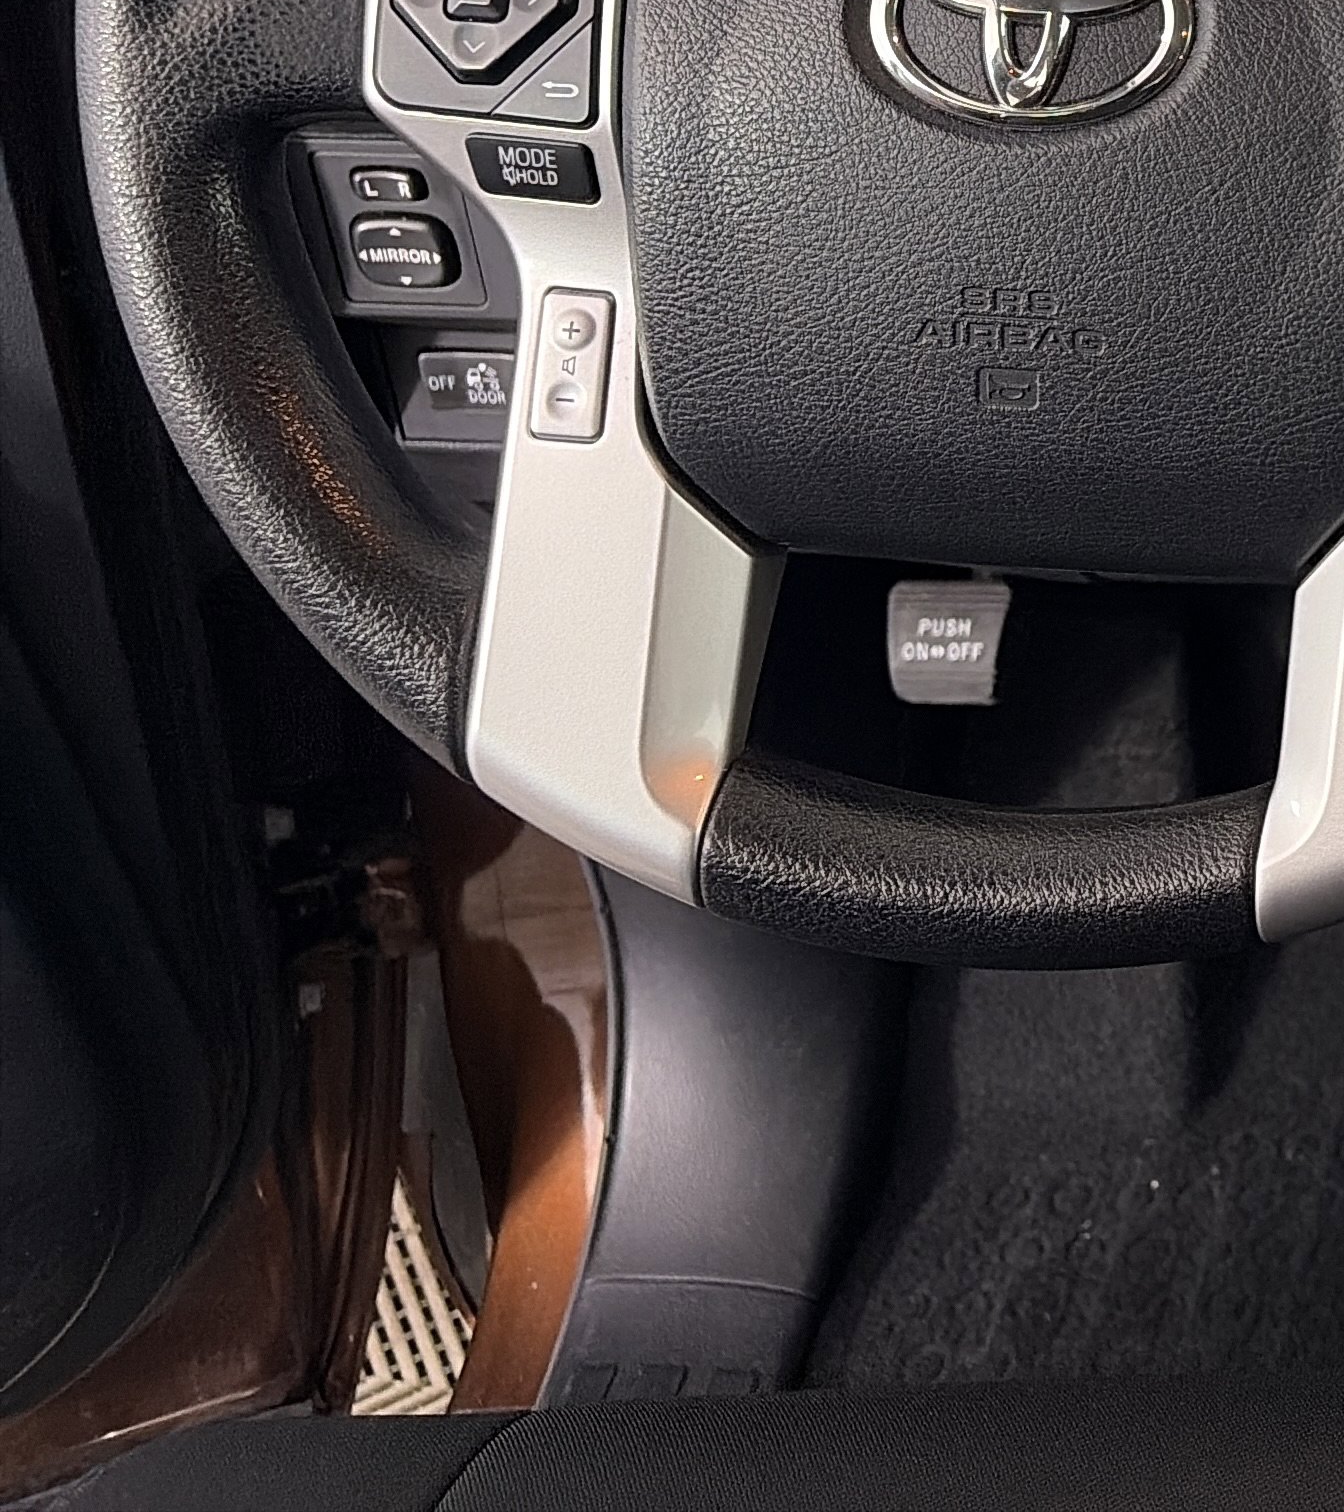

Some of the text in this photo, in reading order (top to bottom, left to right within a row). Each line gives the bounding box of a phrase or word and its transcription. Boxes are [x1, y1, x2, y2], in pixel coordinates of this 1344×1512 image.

[497, 145, 558, 169] MODE
[514, 168, 559, 186] HOLD
[364, 180, 412, 198] L R
[369, 247, 432, 264] MIRROR
[960, 285, 1060, 315] SRS
[428, 374, 456, 392] OFF
[916, 617, 973, 638] PUSH
